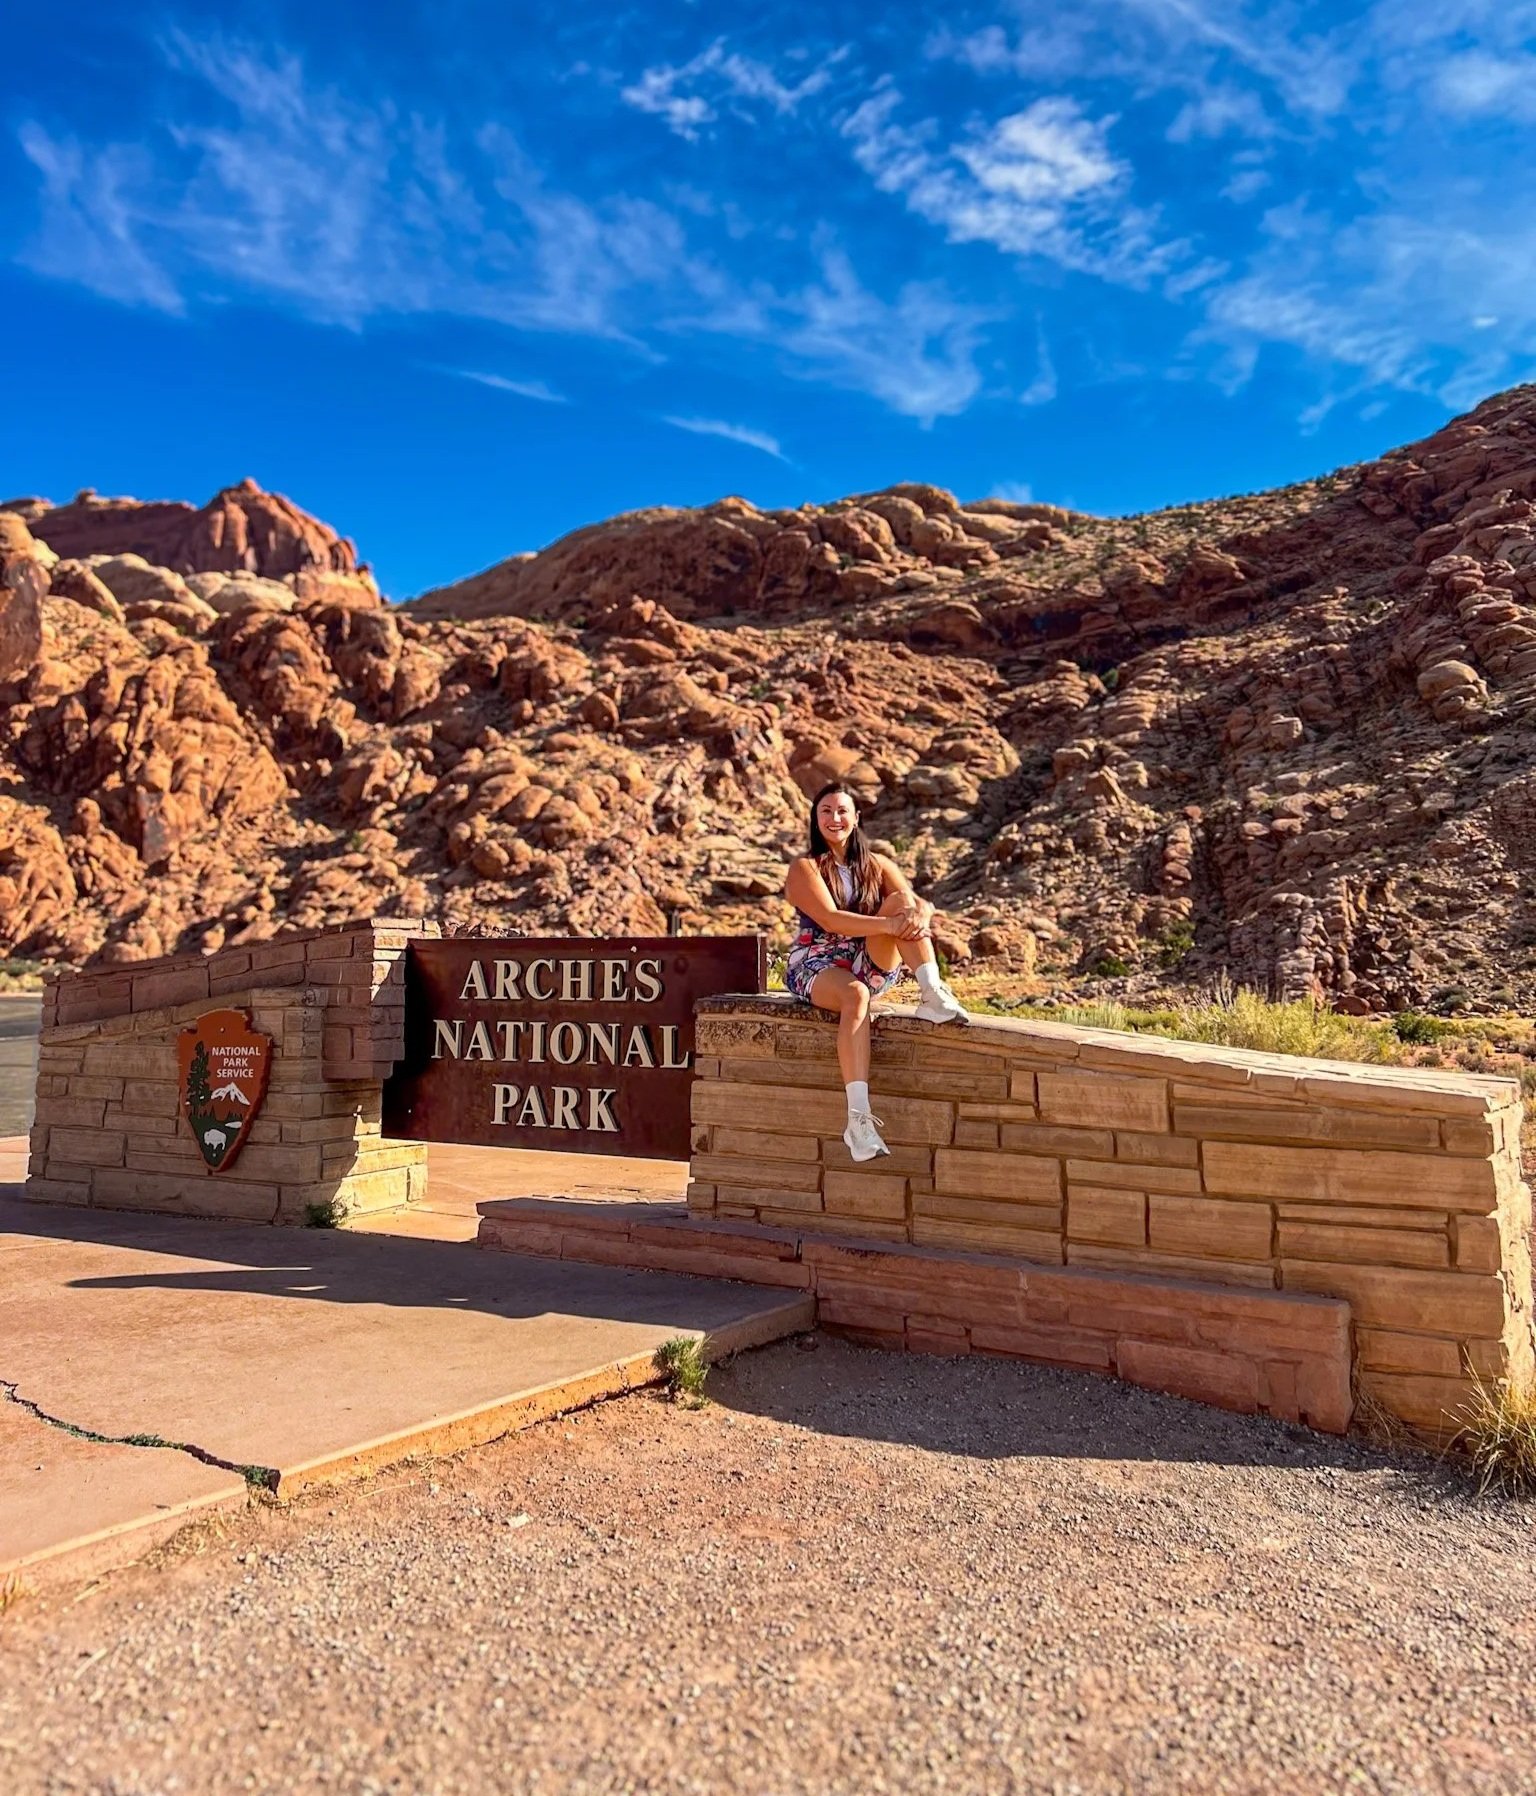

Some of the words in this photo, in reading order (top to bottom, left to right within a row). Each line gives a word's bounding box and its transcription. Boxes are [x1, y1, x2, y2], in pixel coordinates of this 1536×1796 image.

[459, 959, 663, 1003] ARCHES
[212, 1046, 261, 1056] NATIONAL
[431, 1019, 690, 1070] NATIONAL
[216, 1068, 254, 1078] SERVICE
[223, 1057, 248, 1067] PARK
[490, 1083, 620, 1133] PARK
